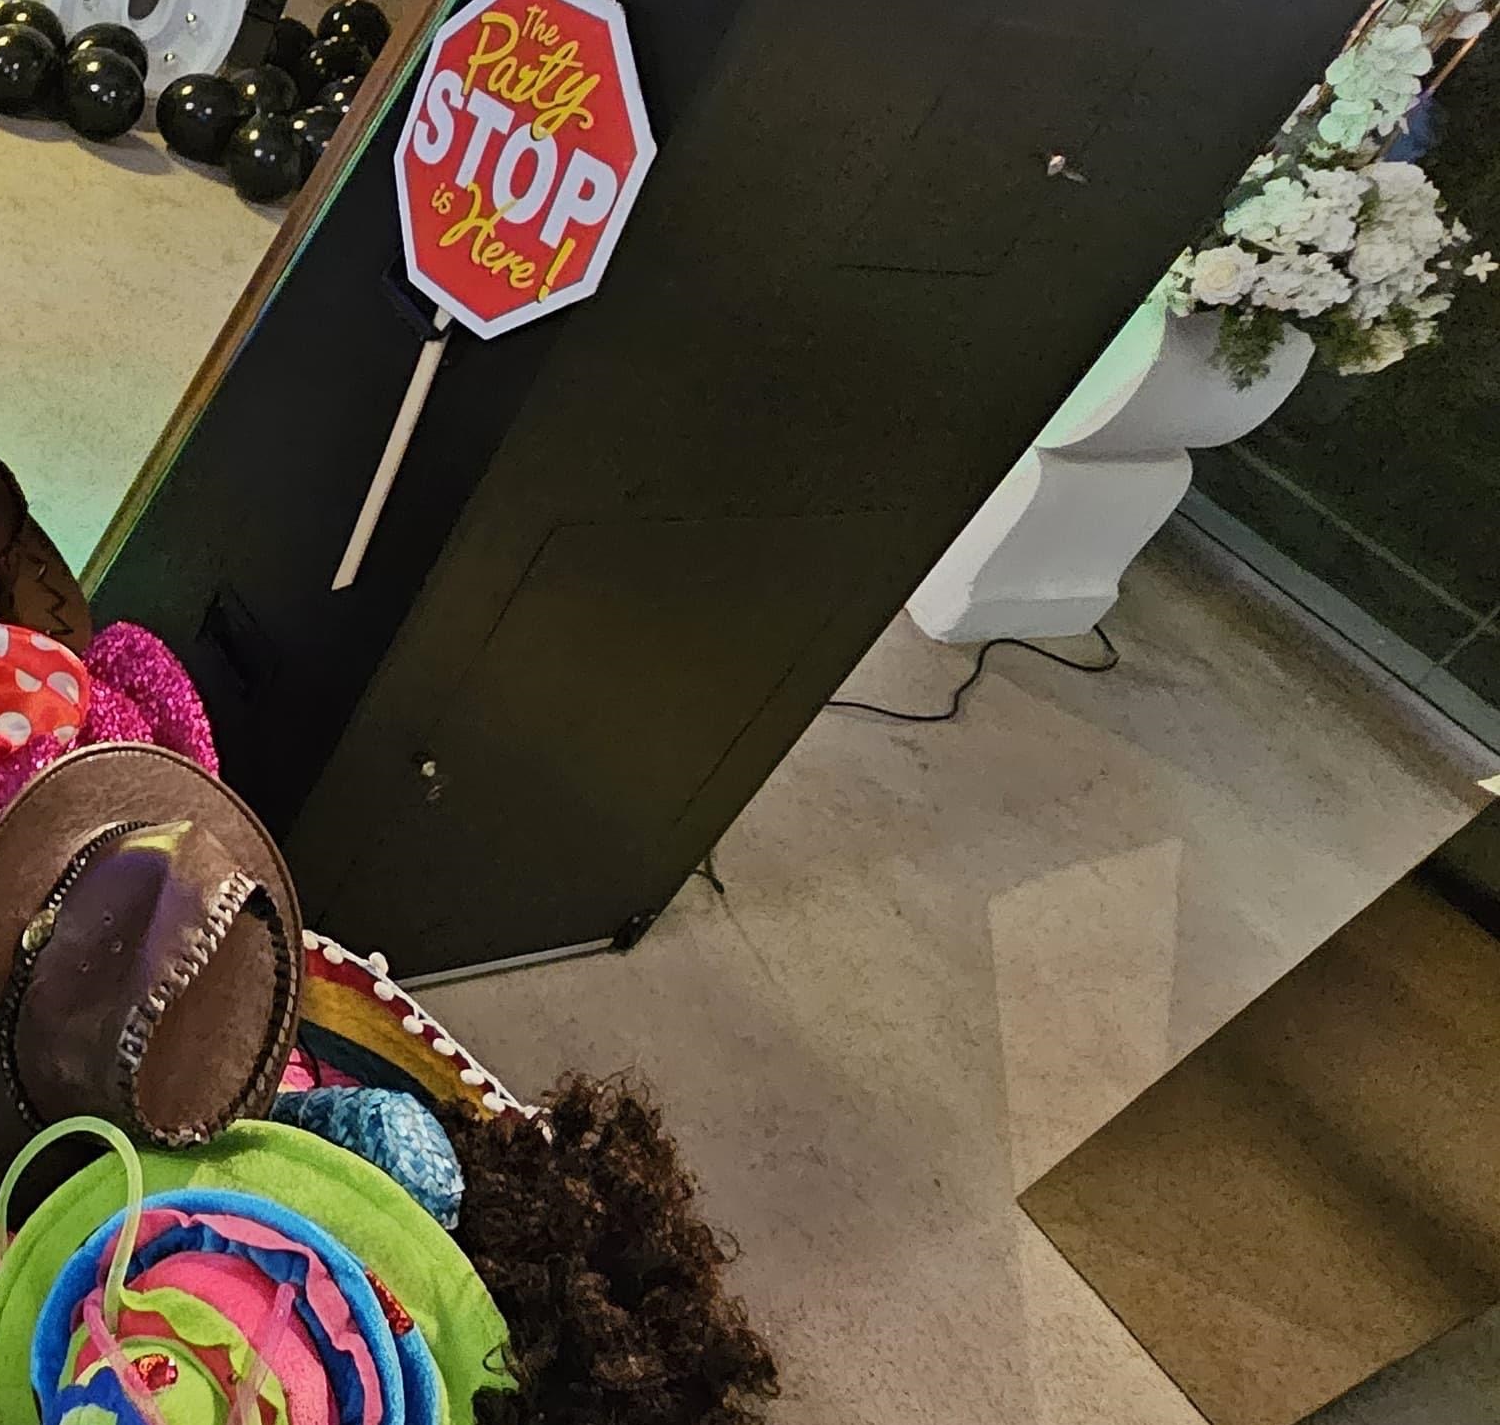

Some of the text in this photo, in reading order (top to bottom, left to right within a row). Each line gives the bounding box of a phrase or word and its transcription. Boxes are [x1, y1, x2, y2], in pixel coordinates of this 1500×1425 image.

[520, 2, 561, 48] The
[462, 11, 601, 143] Party
[412, 68, 618, 249] STOP
[431, 182, 456, 217] is
